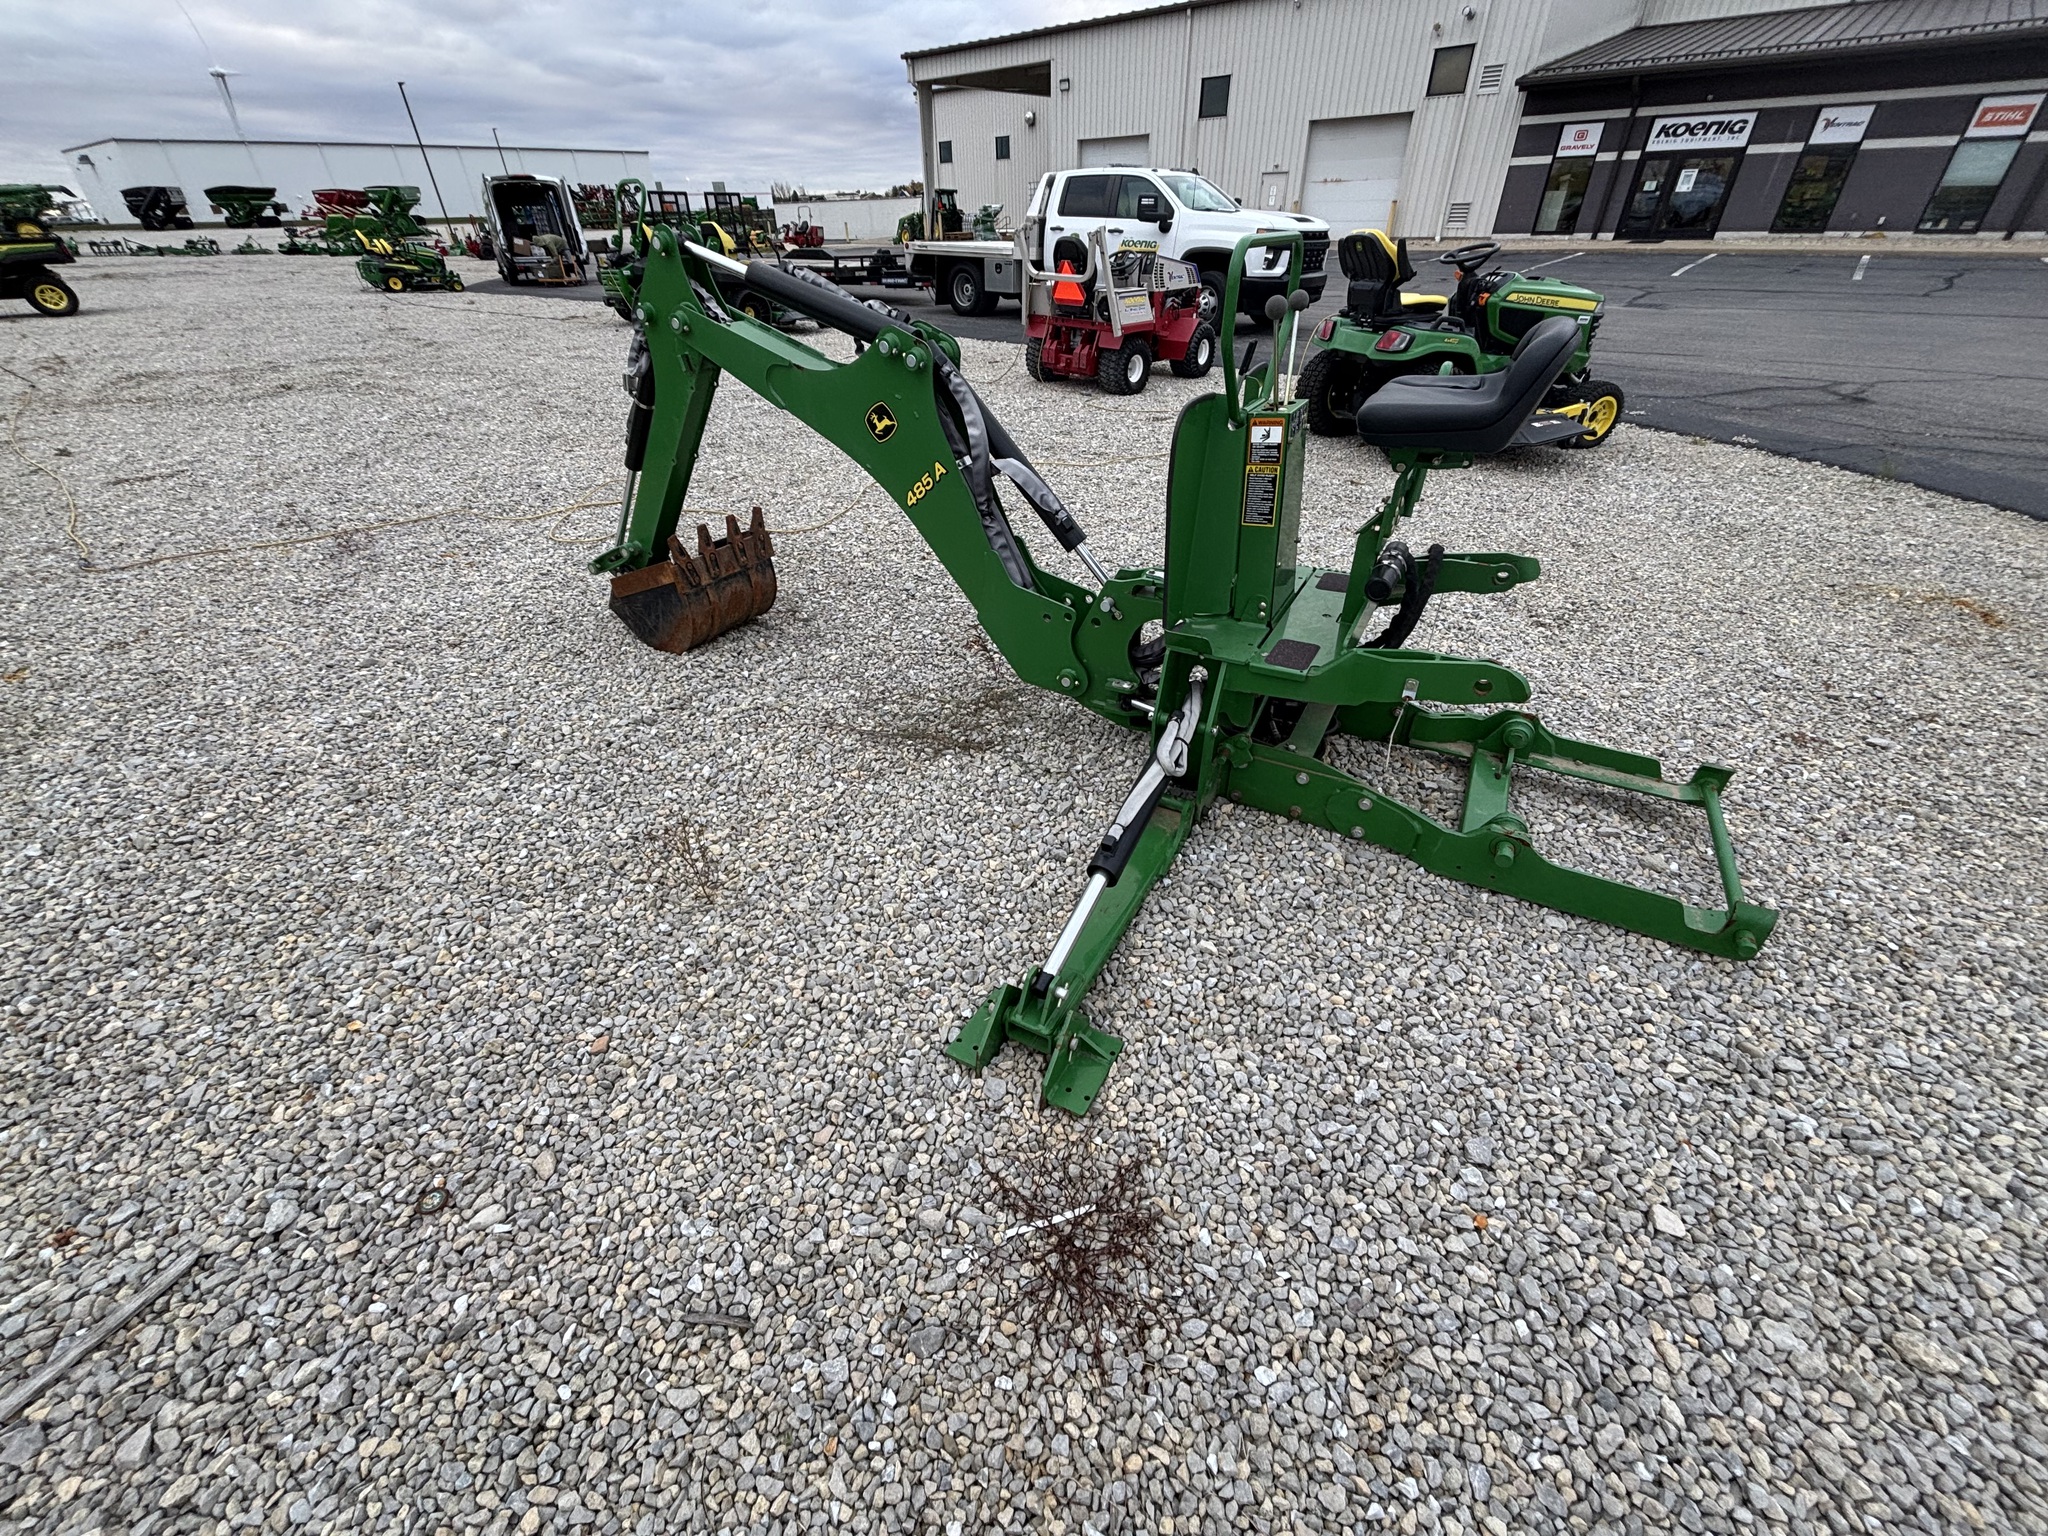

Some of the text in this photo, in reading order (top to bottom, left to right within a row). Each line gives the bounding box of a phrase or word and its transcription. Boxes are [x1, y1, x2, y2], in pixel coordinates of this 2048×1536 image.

[1980, 109, 2029, 122] STIHL
[1560, 143, 1596, 151] GRAVELY
[1513, 294, 1560, 306] JOHN DEERE
[1254, 466, 1279, 474] CAUTION
[906, 461, 949, 508] 485 A
